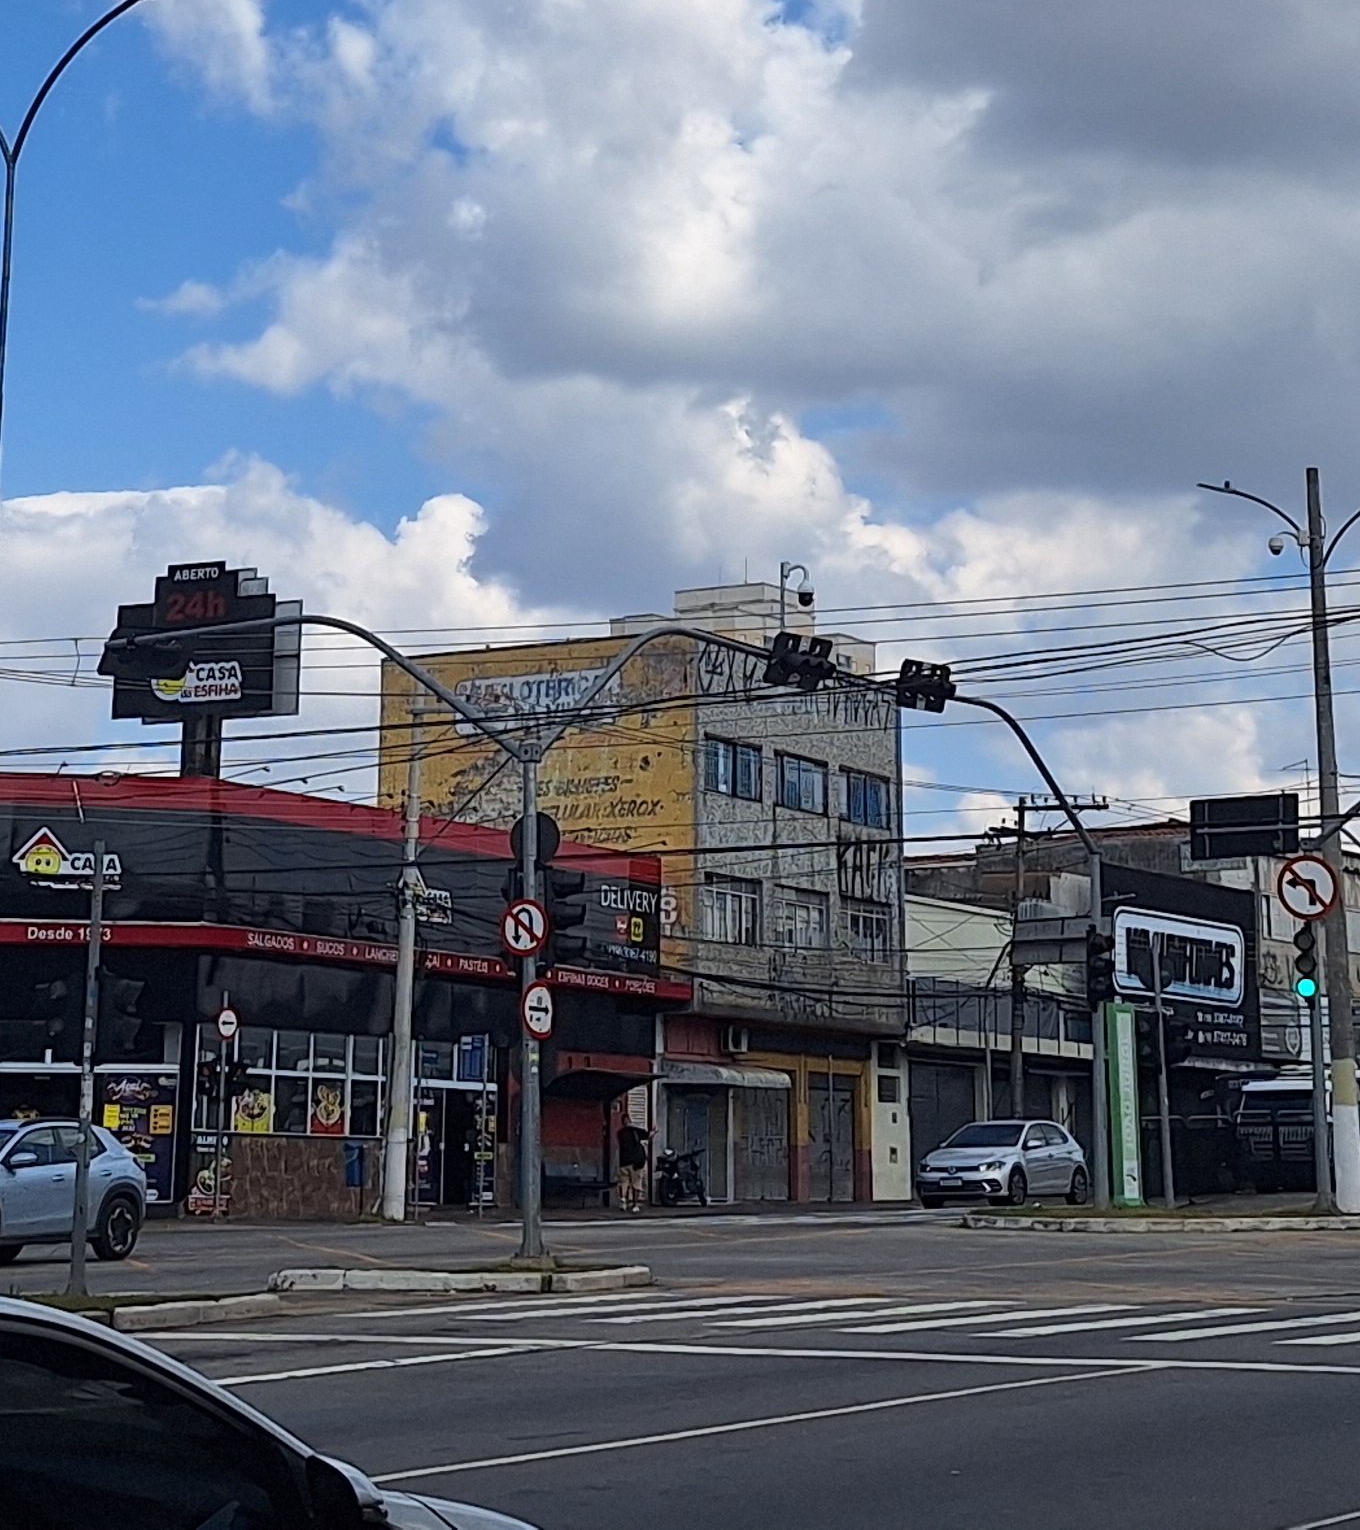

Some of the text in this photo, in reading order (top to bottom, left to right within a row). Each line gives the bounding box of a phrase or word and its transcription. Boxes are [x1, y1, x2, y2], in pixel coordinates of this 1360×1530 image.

[173, 567, 220, 582] ABERTO
[166, 590, 227, 621] 24h
[195, 665, 239, 682] CASA
[193, 683, 239, 699] ESFIHA
[70, 857, 117, 872] CAA
[601, 884, 658, 915] DELIVERY
[27, 926, 112, 941] Desde 193
[247, 931, 295, 950] SALGADOS
[316, 940, 345, 956] SUCOS
